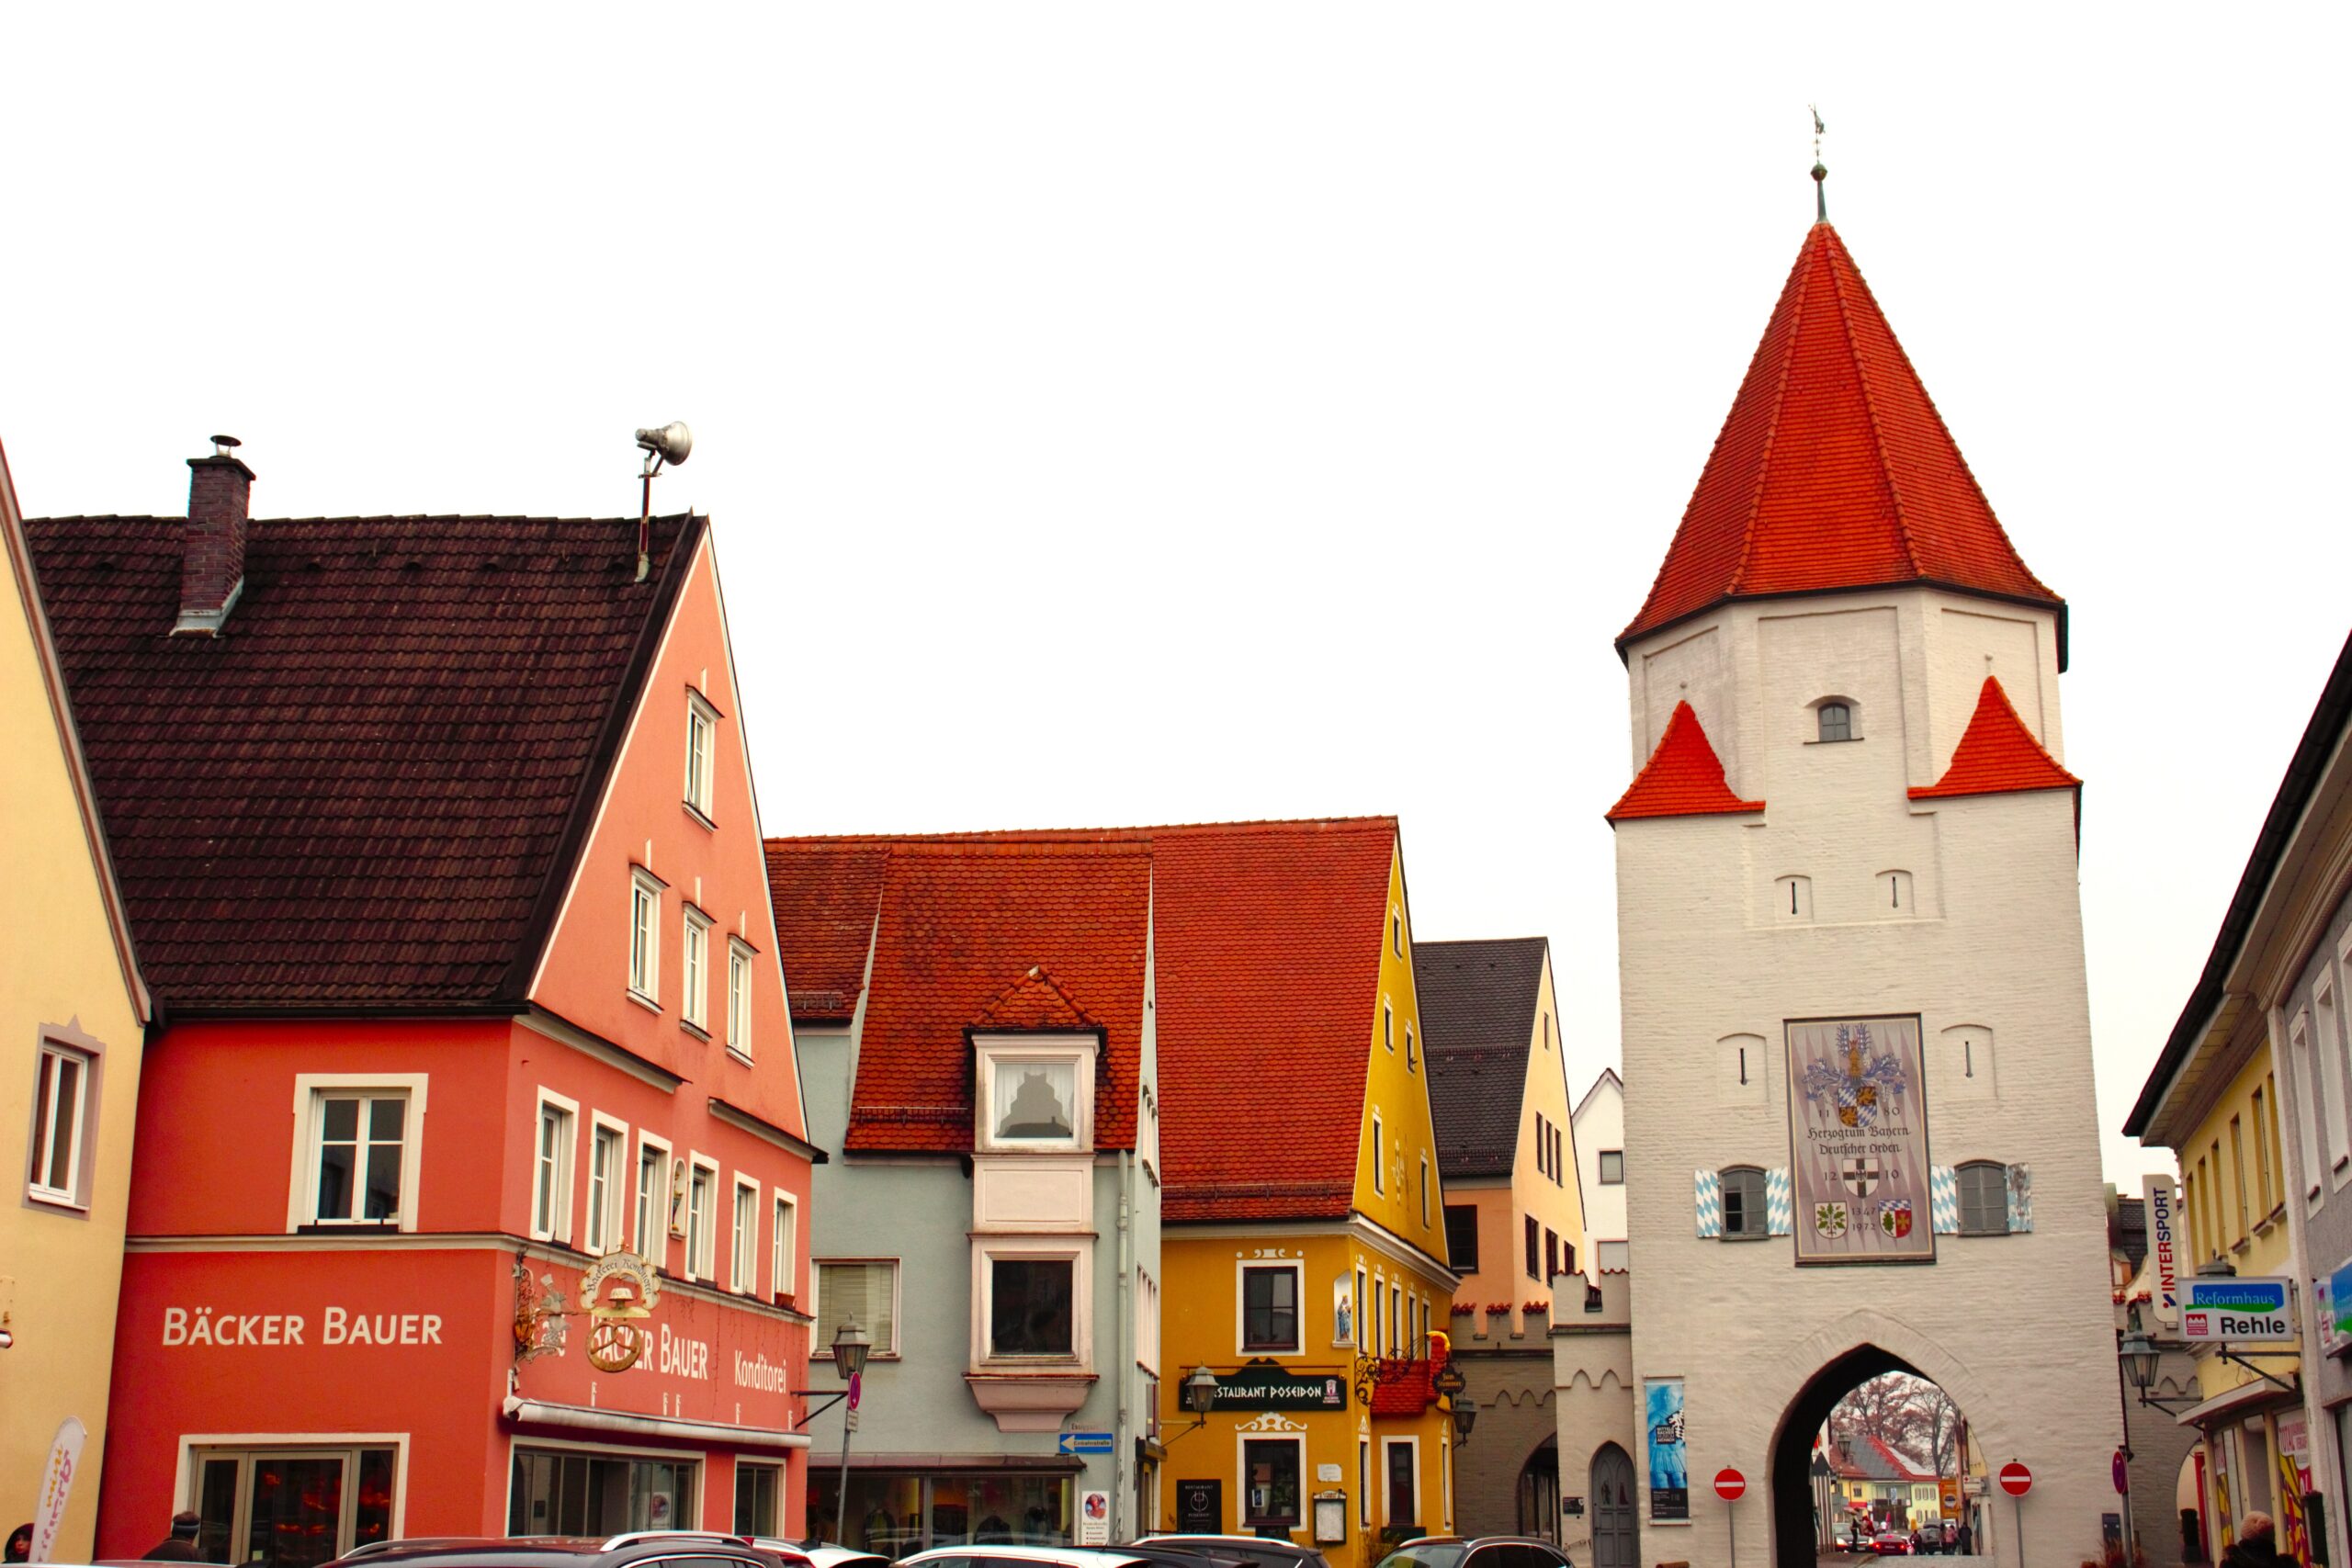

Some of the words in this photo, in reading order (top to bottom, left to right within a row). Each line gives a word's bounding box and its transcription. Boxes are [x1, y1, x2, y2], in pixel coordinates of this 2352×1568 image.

[1807, 1126, 1865, 1141] Herzogtum
[1824, 1171, 1838, 1181] 12
[1885, 1169, 1899, 1180] 10
[1852, 1223, 1876, 1232] 1972
[2153, 1187, 2176, 1292] INTERSPORT
[2196, 1292, 2276, 1309] Reformhaus
[162, 1306, 305, 1346] BÄCKER
[322, 1306, 443, 1345] BAUER
[2220, 1315, 2286, 1335] Rehle
[660, 1323, 708, 1381] BAUER
[734, 1349, 786, 1393] Konditorei
[1213, 1385, 1267, 1399] STAURANT
[1270, 1385, 1322, 1399] POSEIDON
